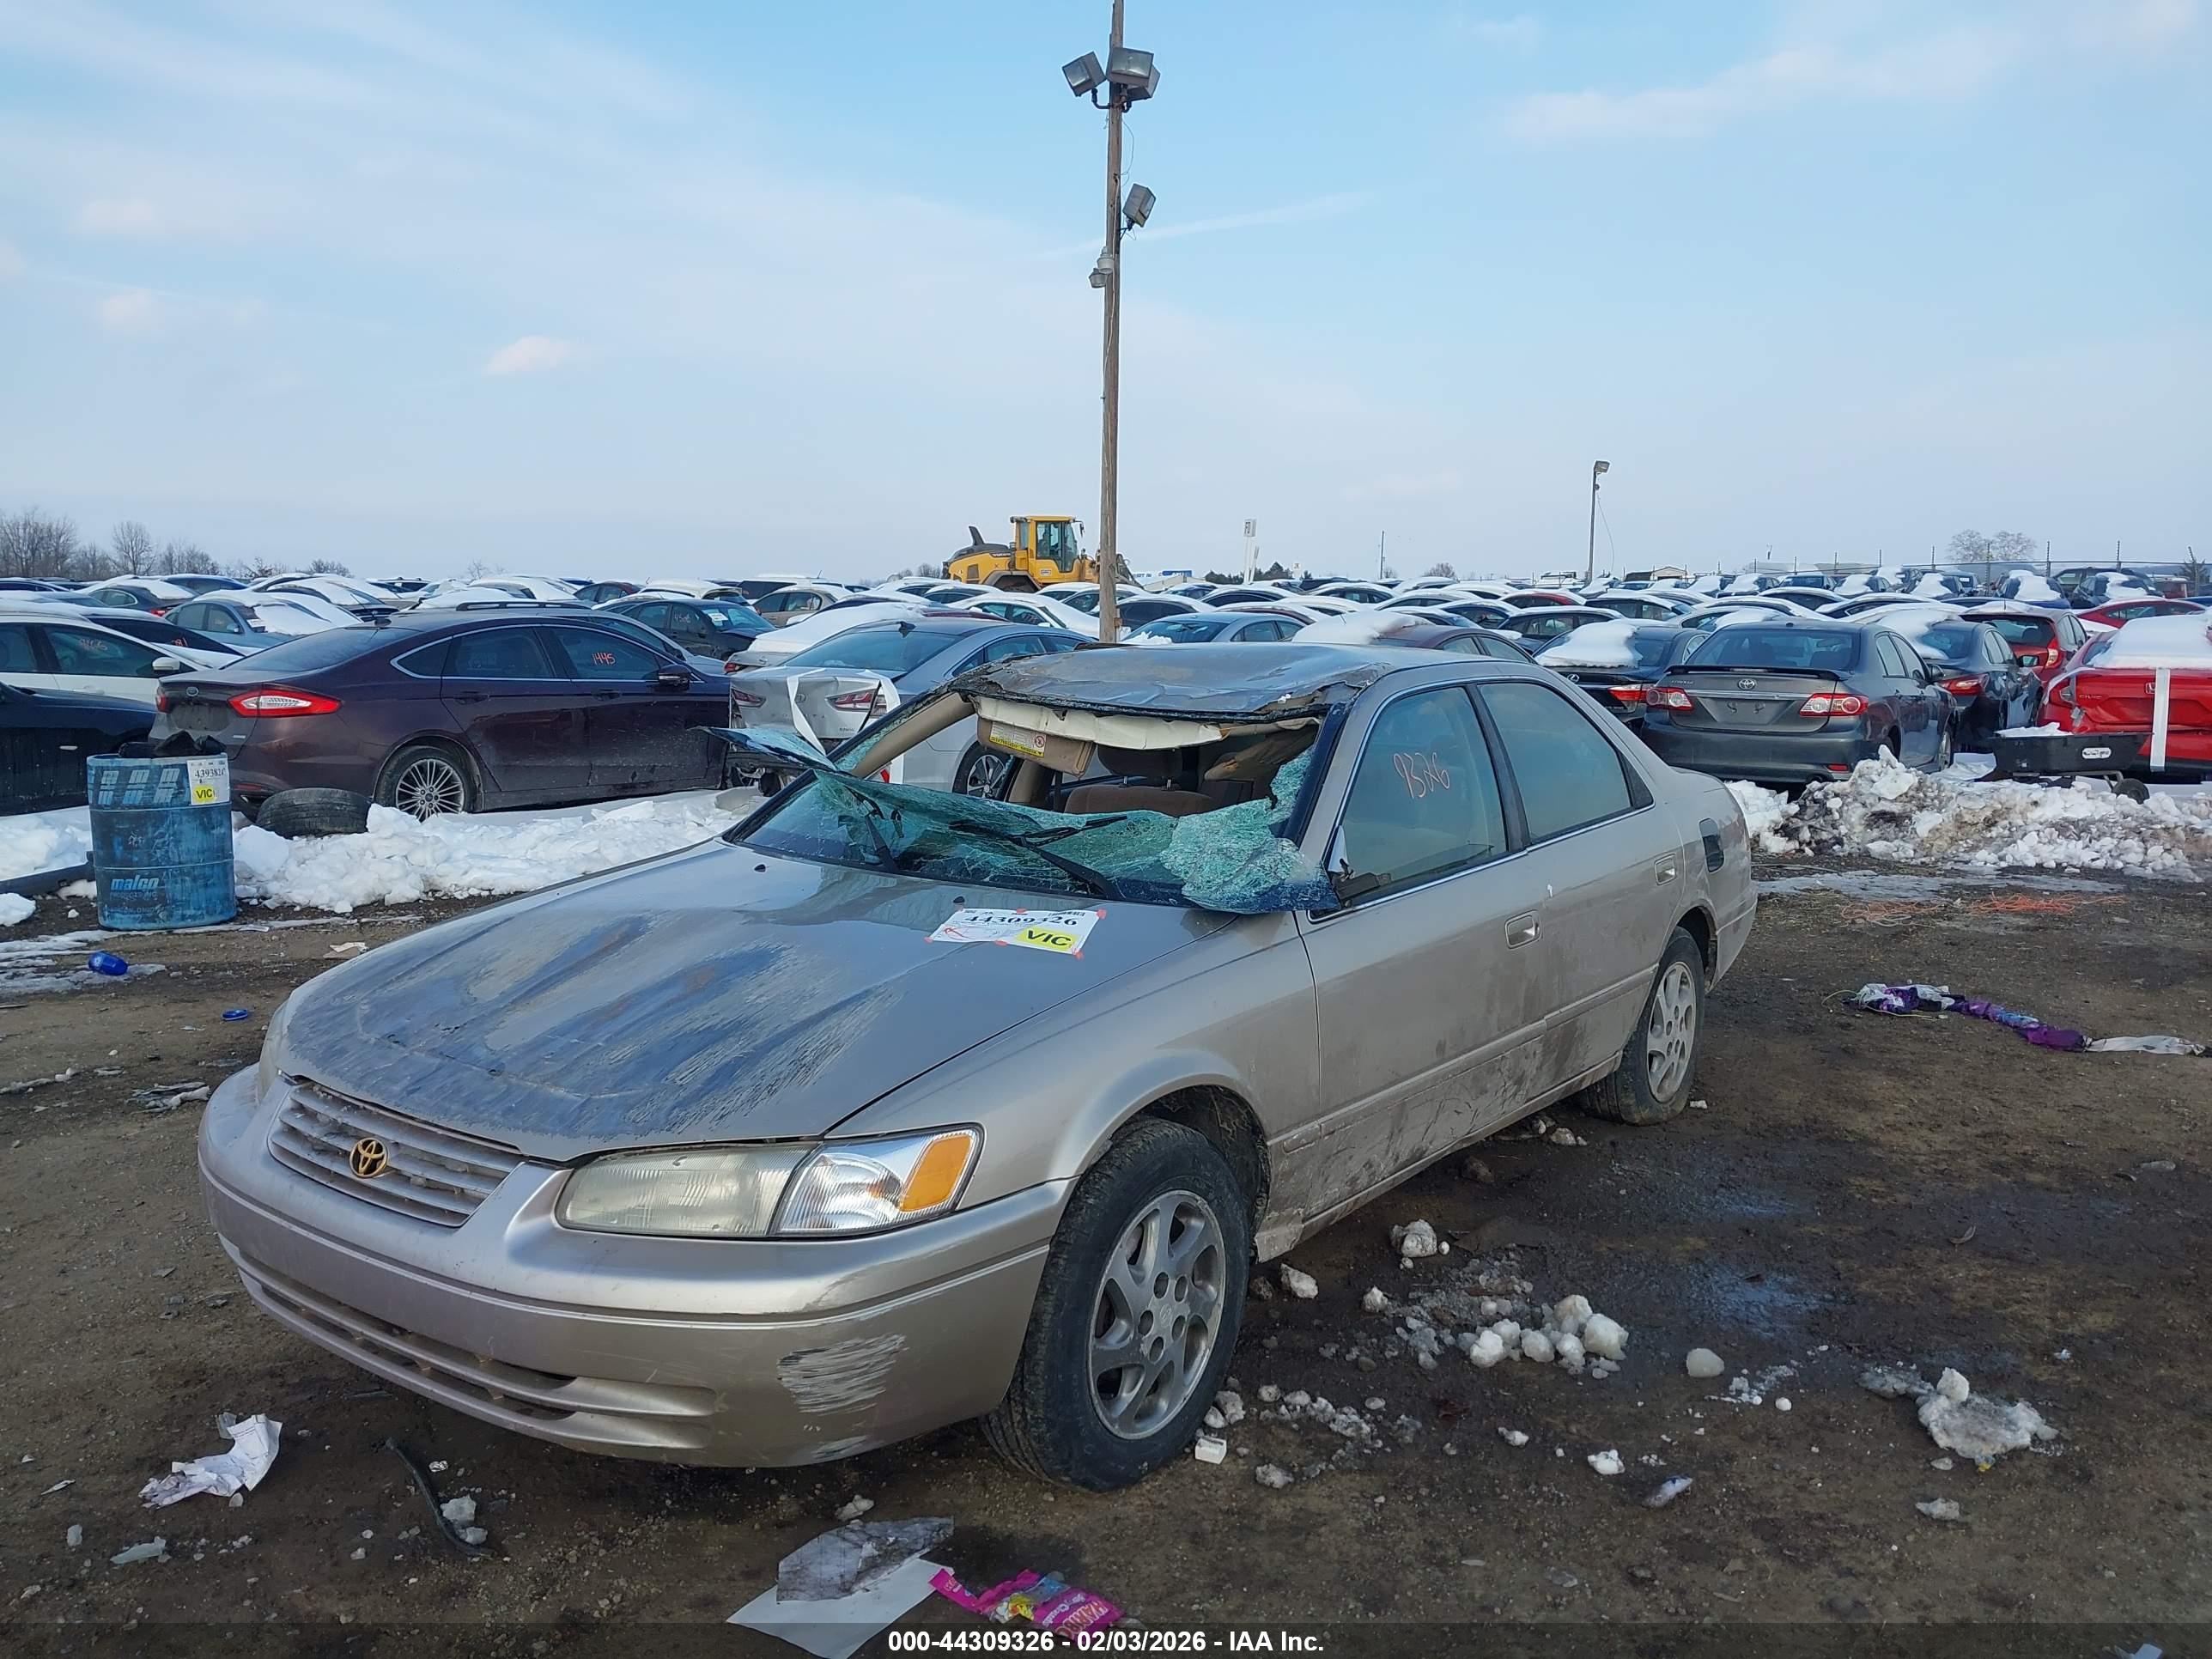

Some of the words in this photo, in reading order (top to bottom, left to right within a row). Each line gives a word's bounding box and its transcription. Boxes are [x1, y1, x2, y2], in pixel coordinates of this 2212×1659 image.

[592, 652, 616, 665] 1445
[111, 874, 160, 890] malco
[1027, 930, 1072, 946] VIC
